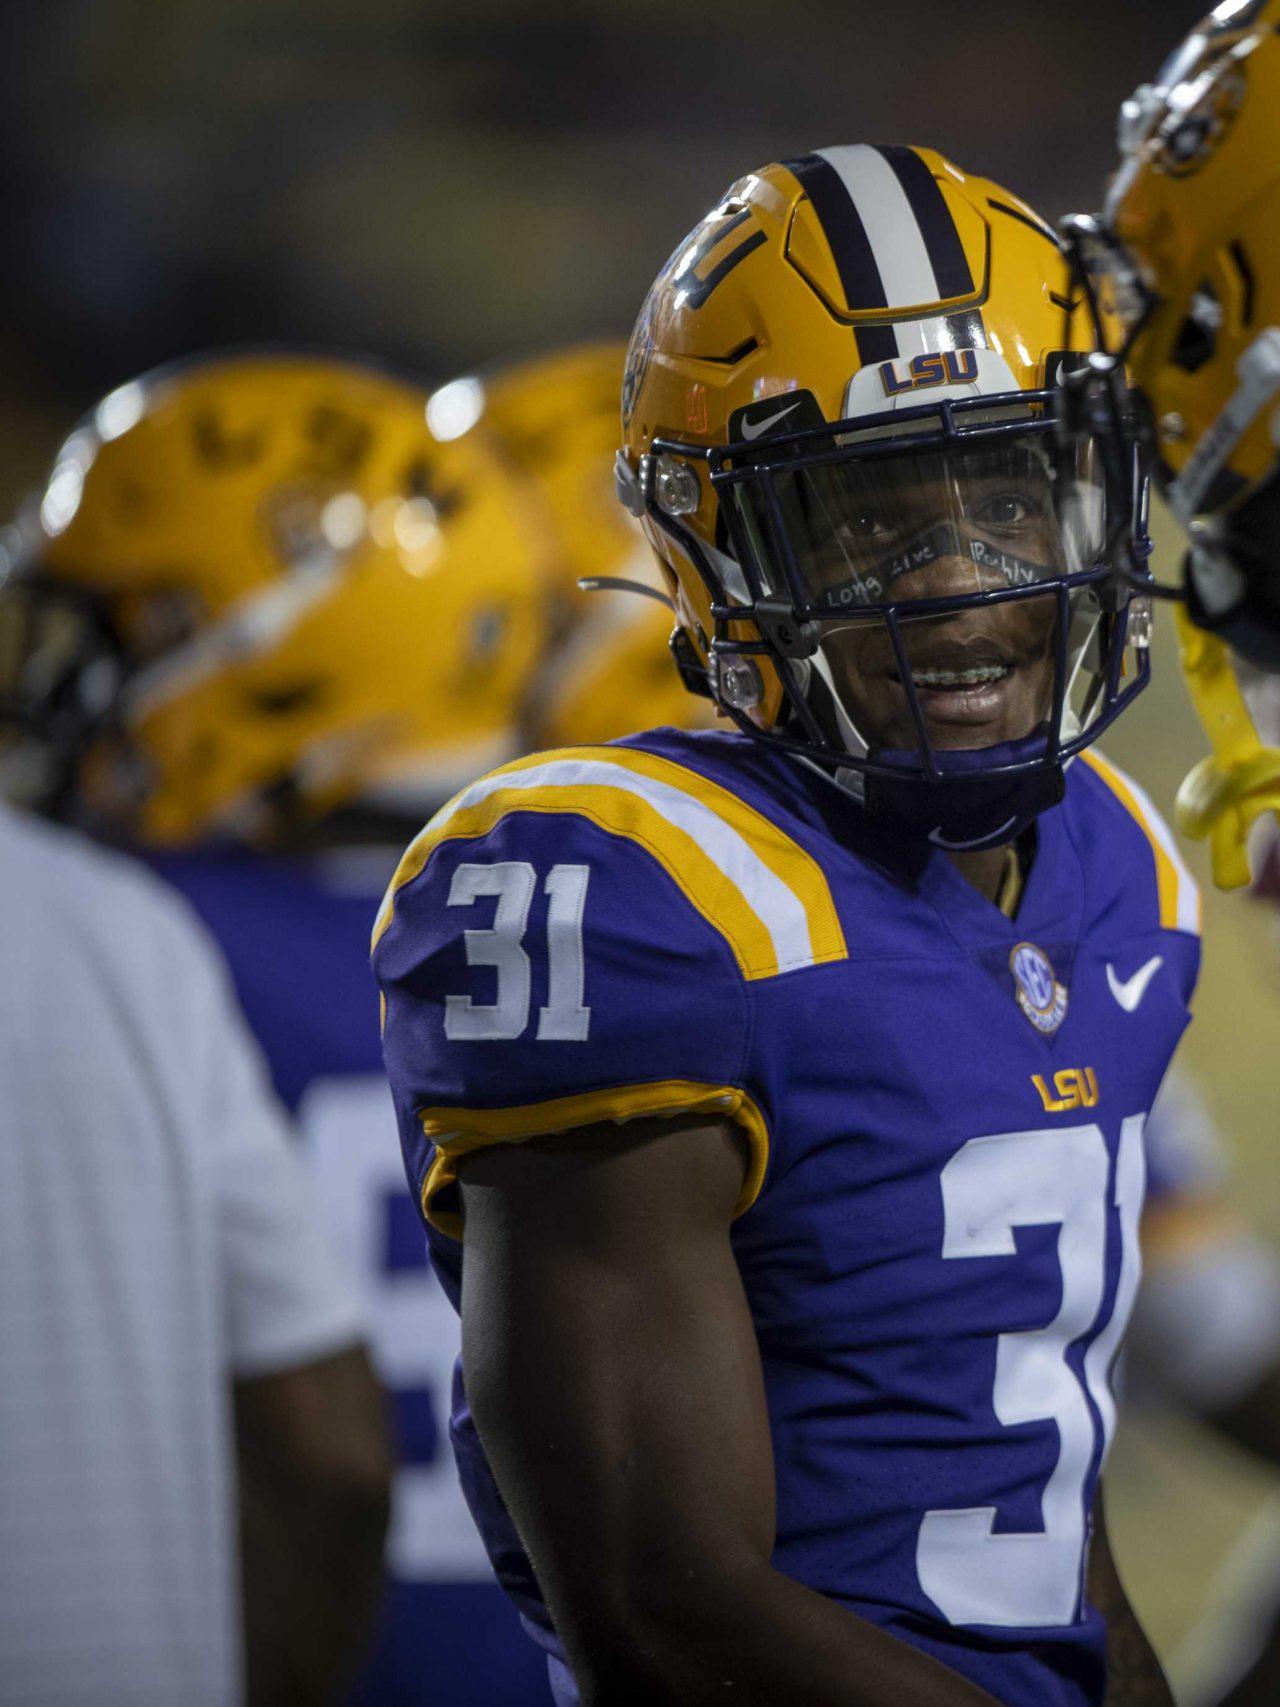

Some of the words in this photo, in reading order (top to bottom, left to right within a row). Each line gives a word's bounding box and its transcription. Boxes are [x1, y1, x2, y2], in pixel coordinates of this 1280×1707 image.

[878, 350, 979, 398] LSU
[443, 861, 591, 1042] 31
[1031, 1066, 1099, 1112] LSU
[916, 1112, 1147, 1626] 31
